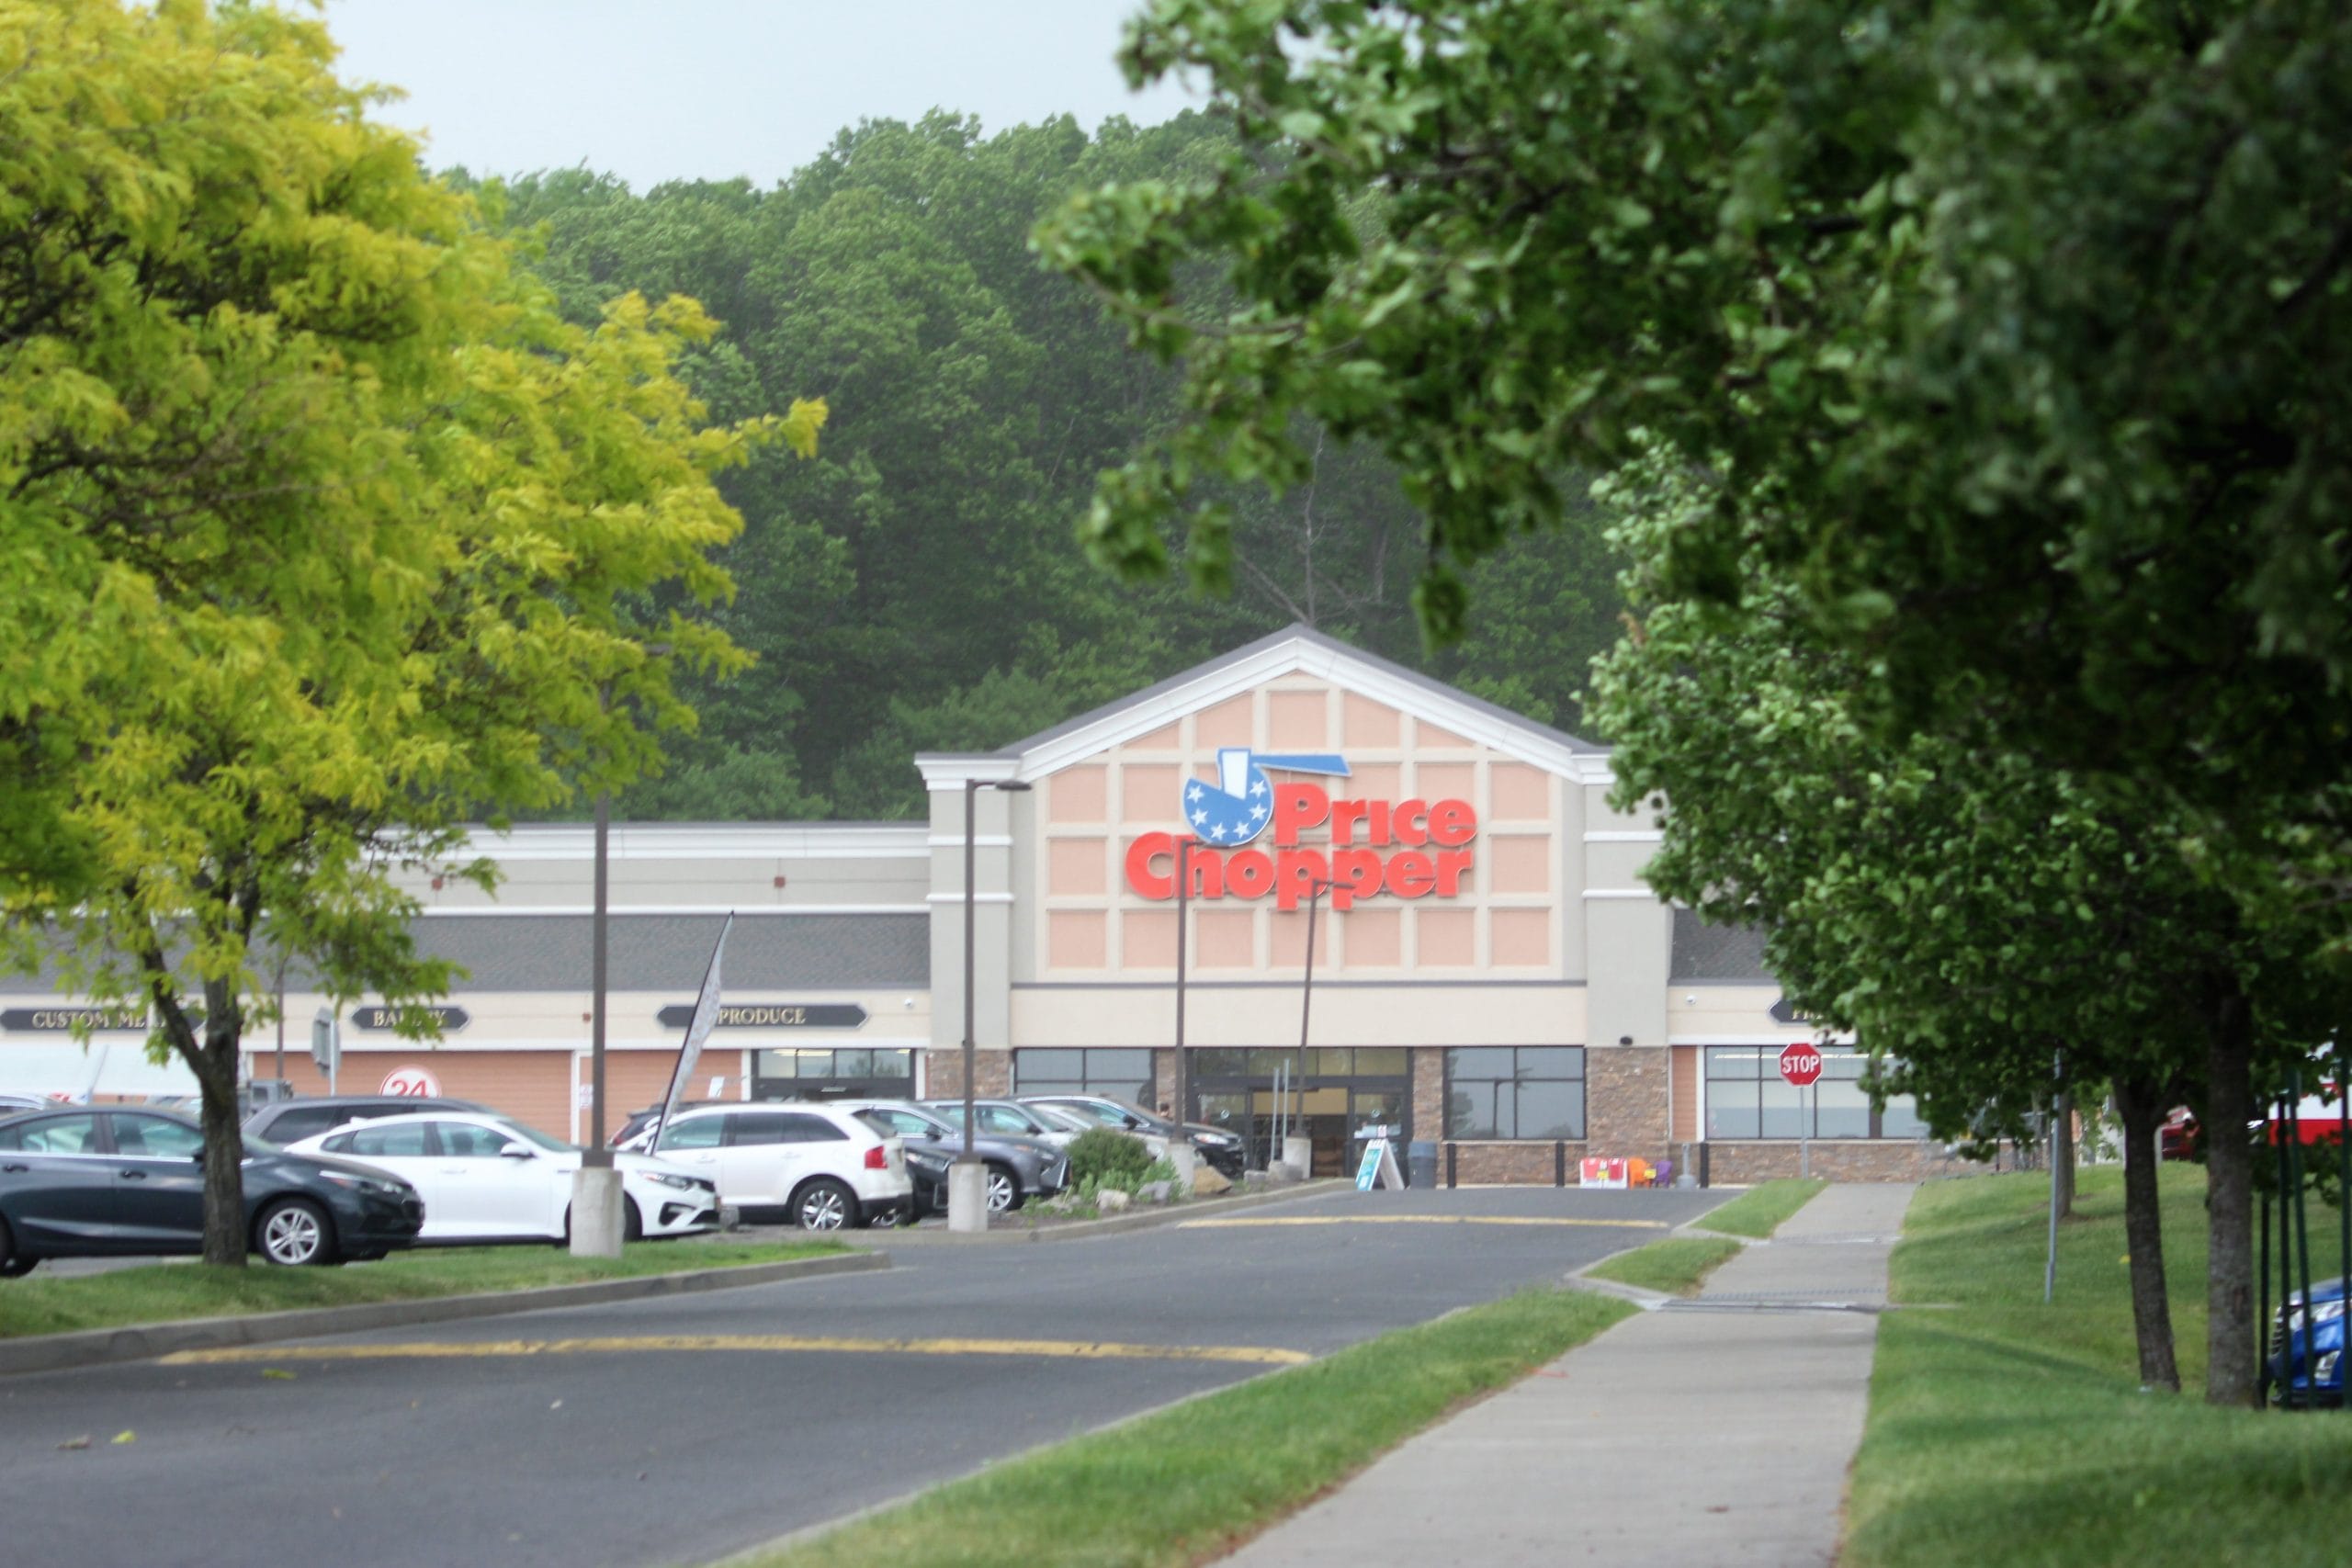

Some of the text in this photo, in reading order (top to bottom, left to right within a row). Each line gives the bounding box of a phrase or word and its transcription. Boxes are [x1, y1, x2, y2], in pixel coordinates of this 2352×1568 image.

[1273, 782, 1477, 847] Price
[1125, 831, 1474, 912] Chopper
[718, 1007, 806, 1025] PRODUCE
[1782, 1055, 1820, 1074] STOP
[390, 1079, 430, 1098] 24
